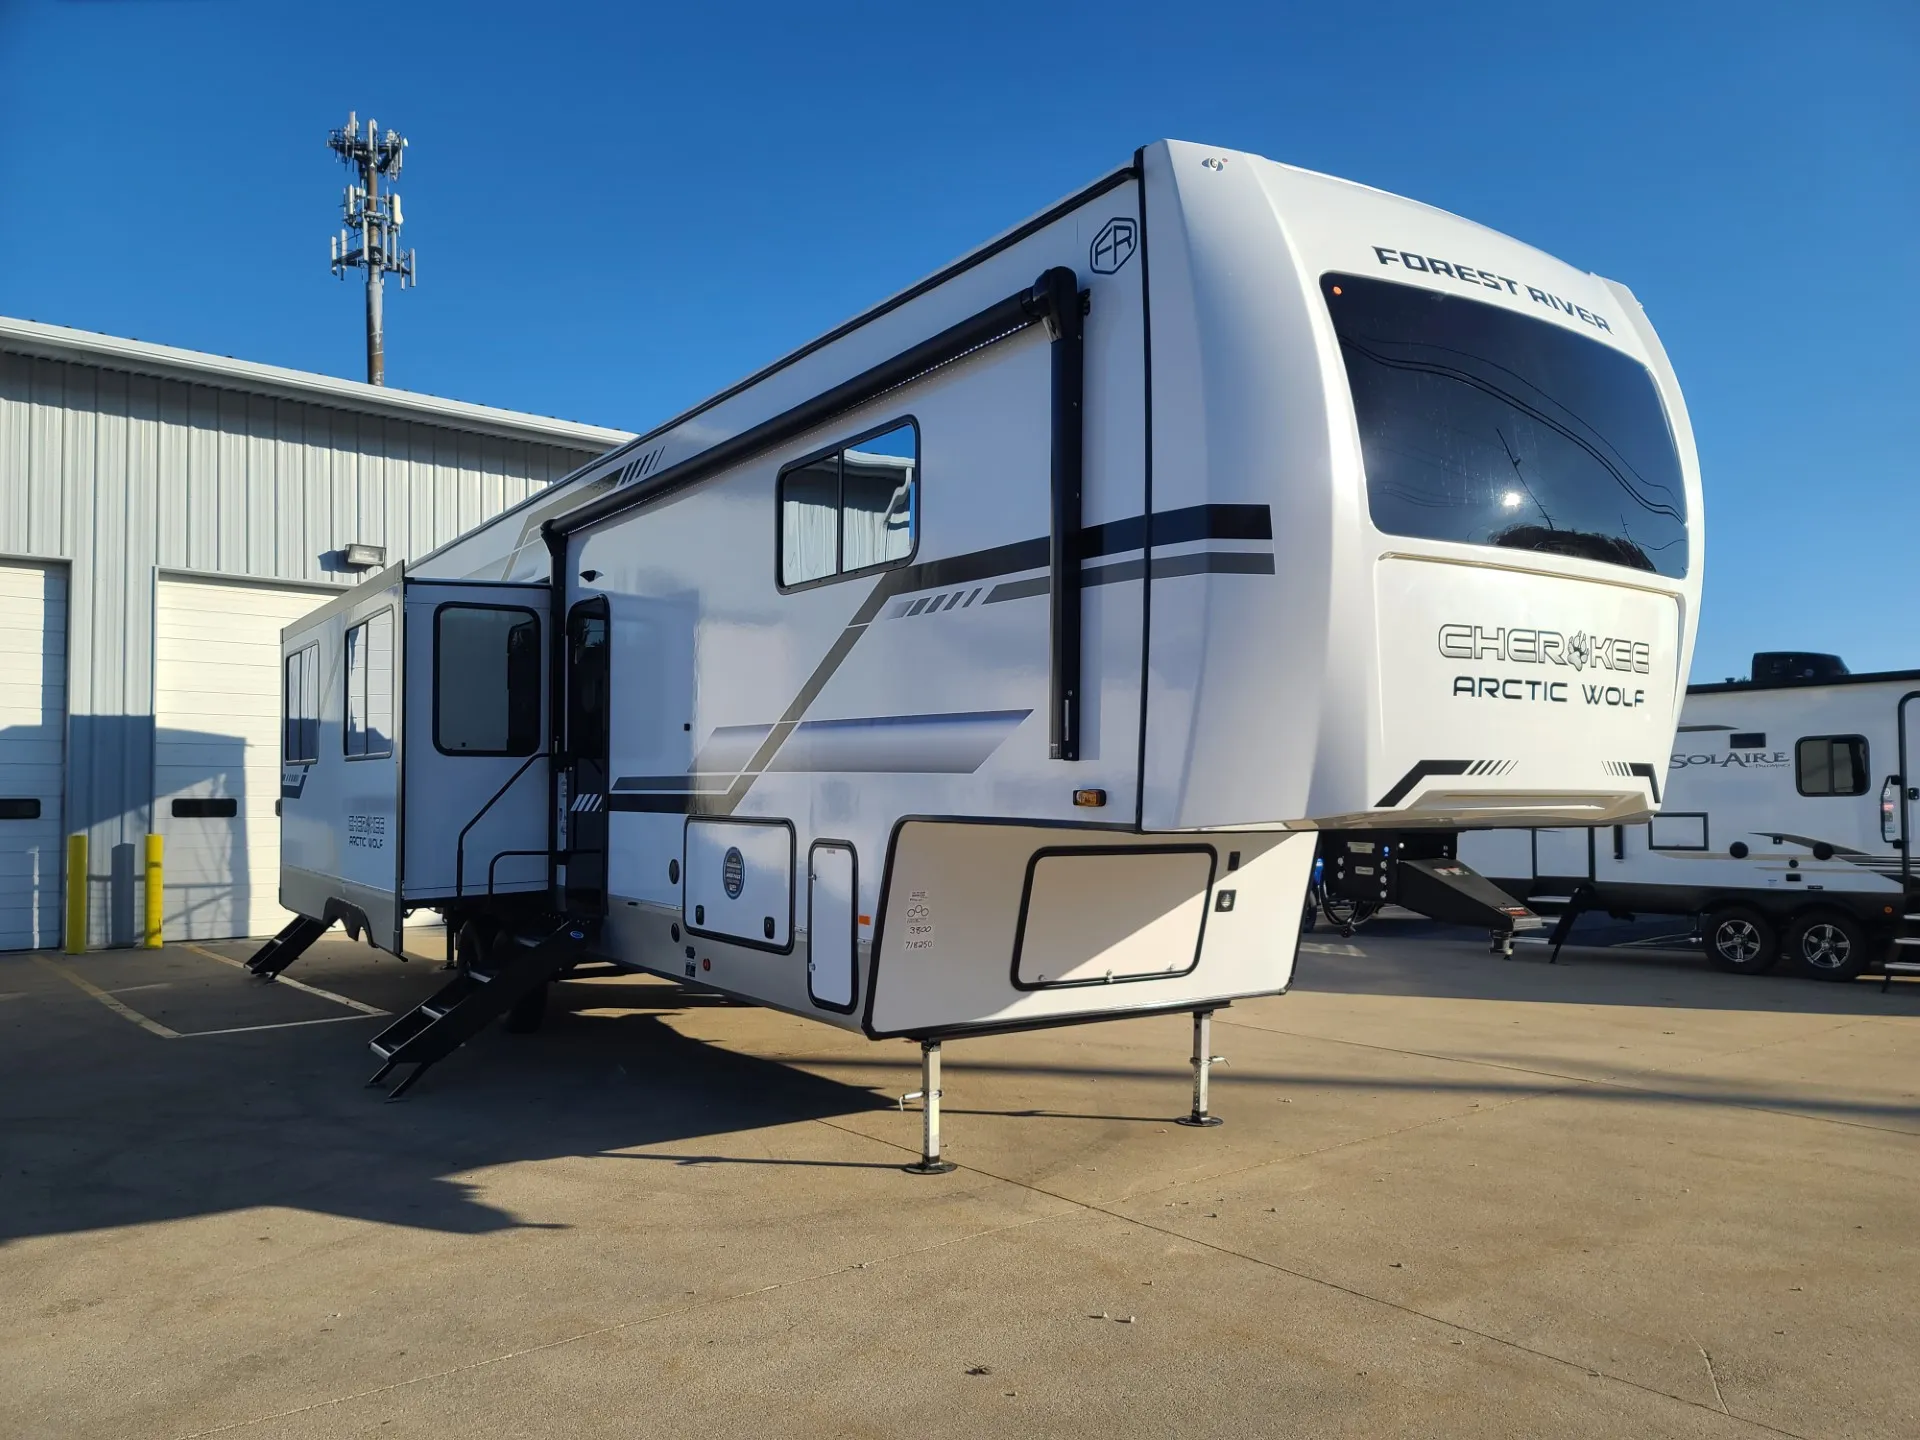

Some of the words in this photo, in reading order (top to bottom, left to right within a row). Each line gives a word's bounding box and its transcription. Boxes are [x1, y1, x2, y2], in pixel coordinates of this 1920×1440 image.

[1371, 245, 1518, 296] FOREST
[1523, 284, 1615, 335] RIVER
[1453, 675, 1568, 702] ARCTIC
[1582, 684, 1645, 707] WOLF
